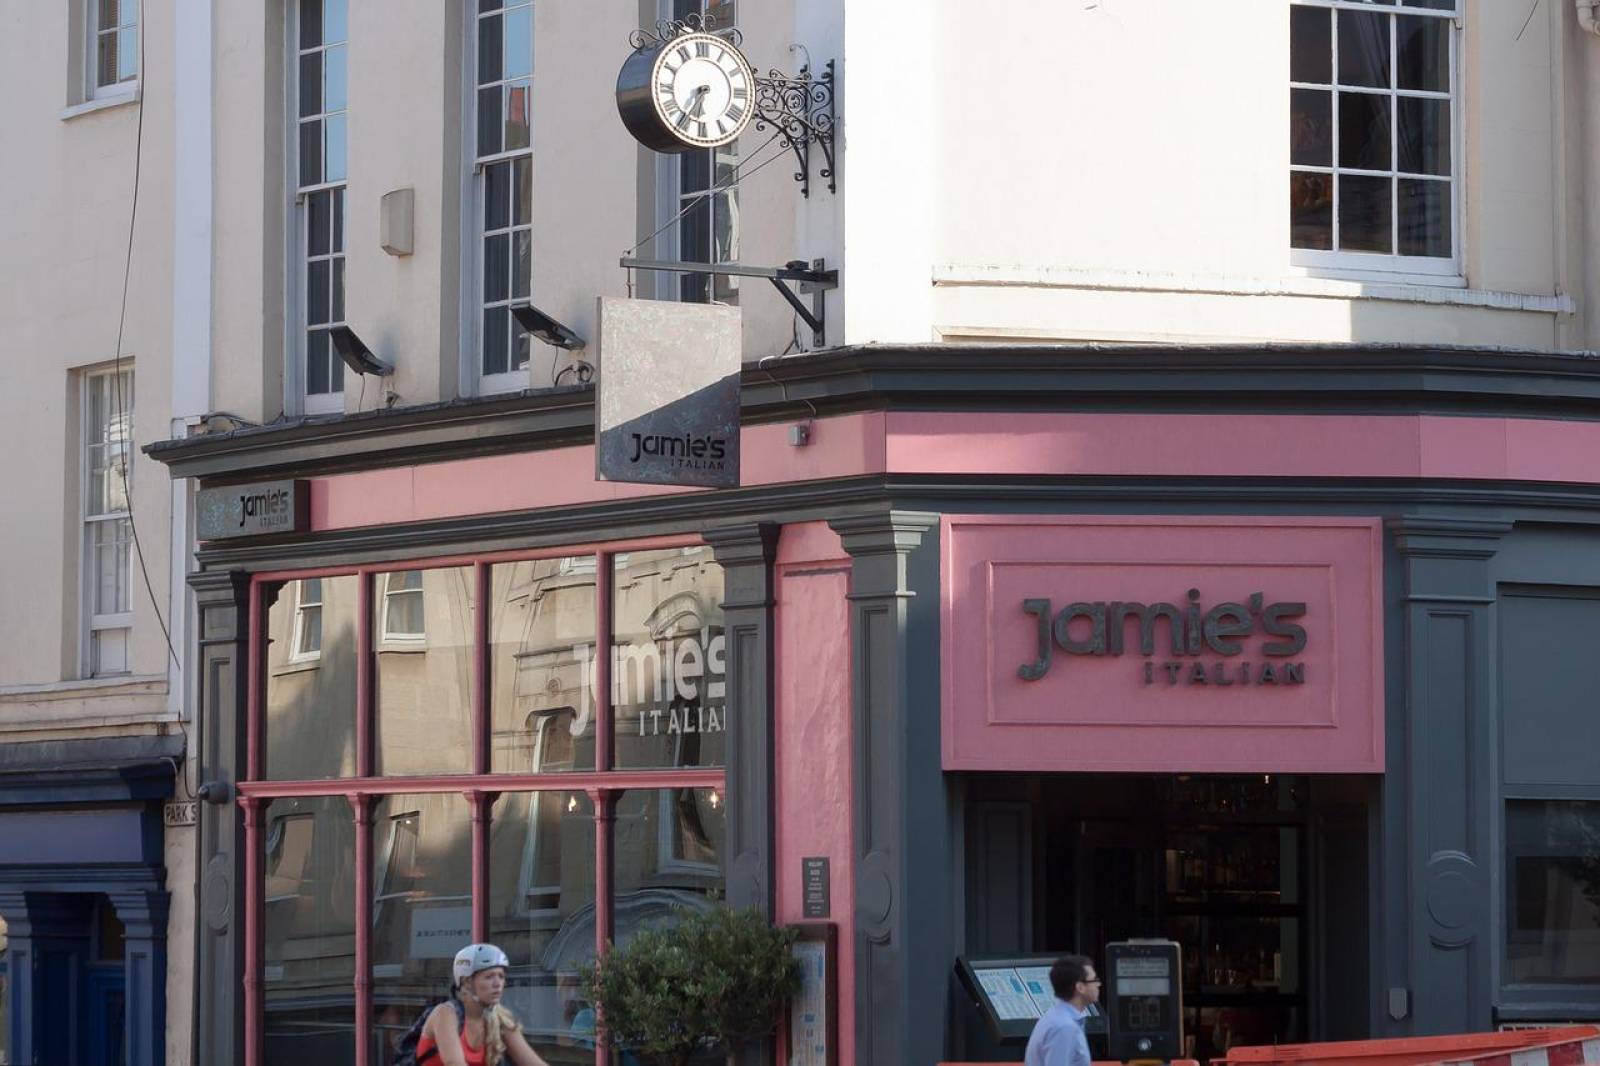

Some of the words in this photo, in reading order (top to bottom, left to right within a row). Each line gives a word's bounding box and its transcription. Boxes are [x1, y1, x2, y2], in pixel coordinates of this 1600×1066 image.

[1143, 661, 1305, 684] ITALIAN
[639, 705, 725, 736] ITALIA
[166, 805, 188, 824] PARK
